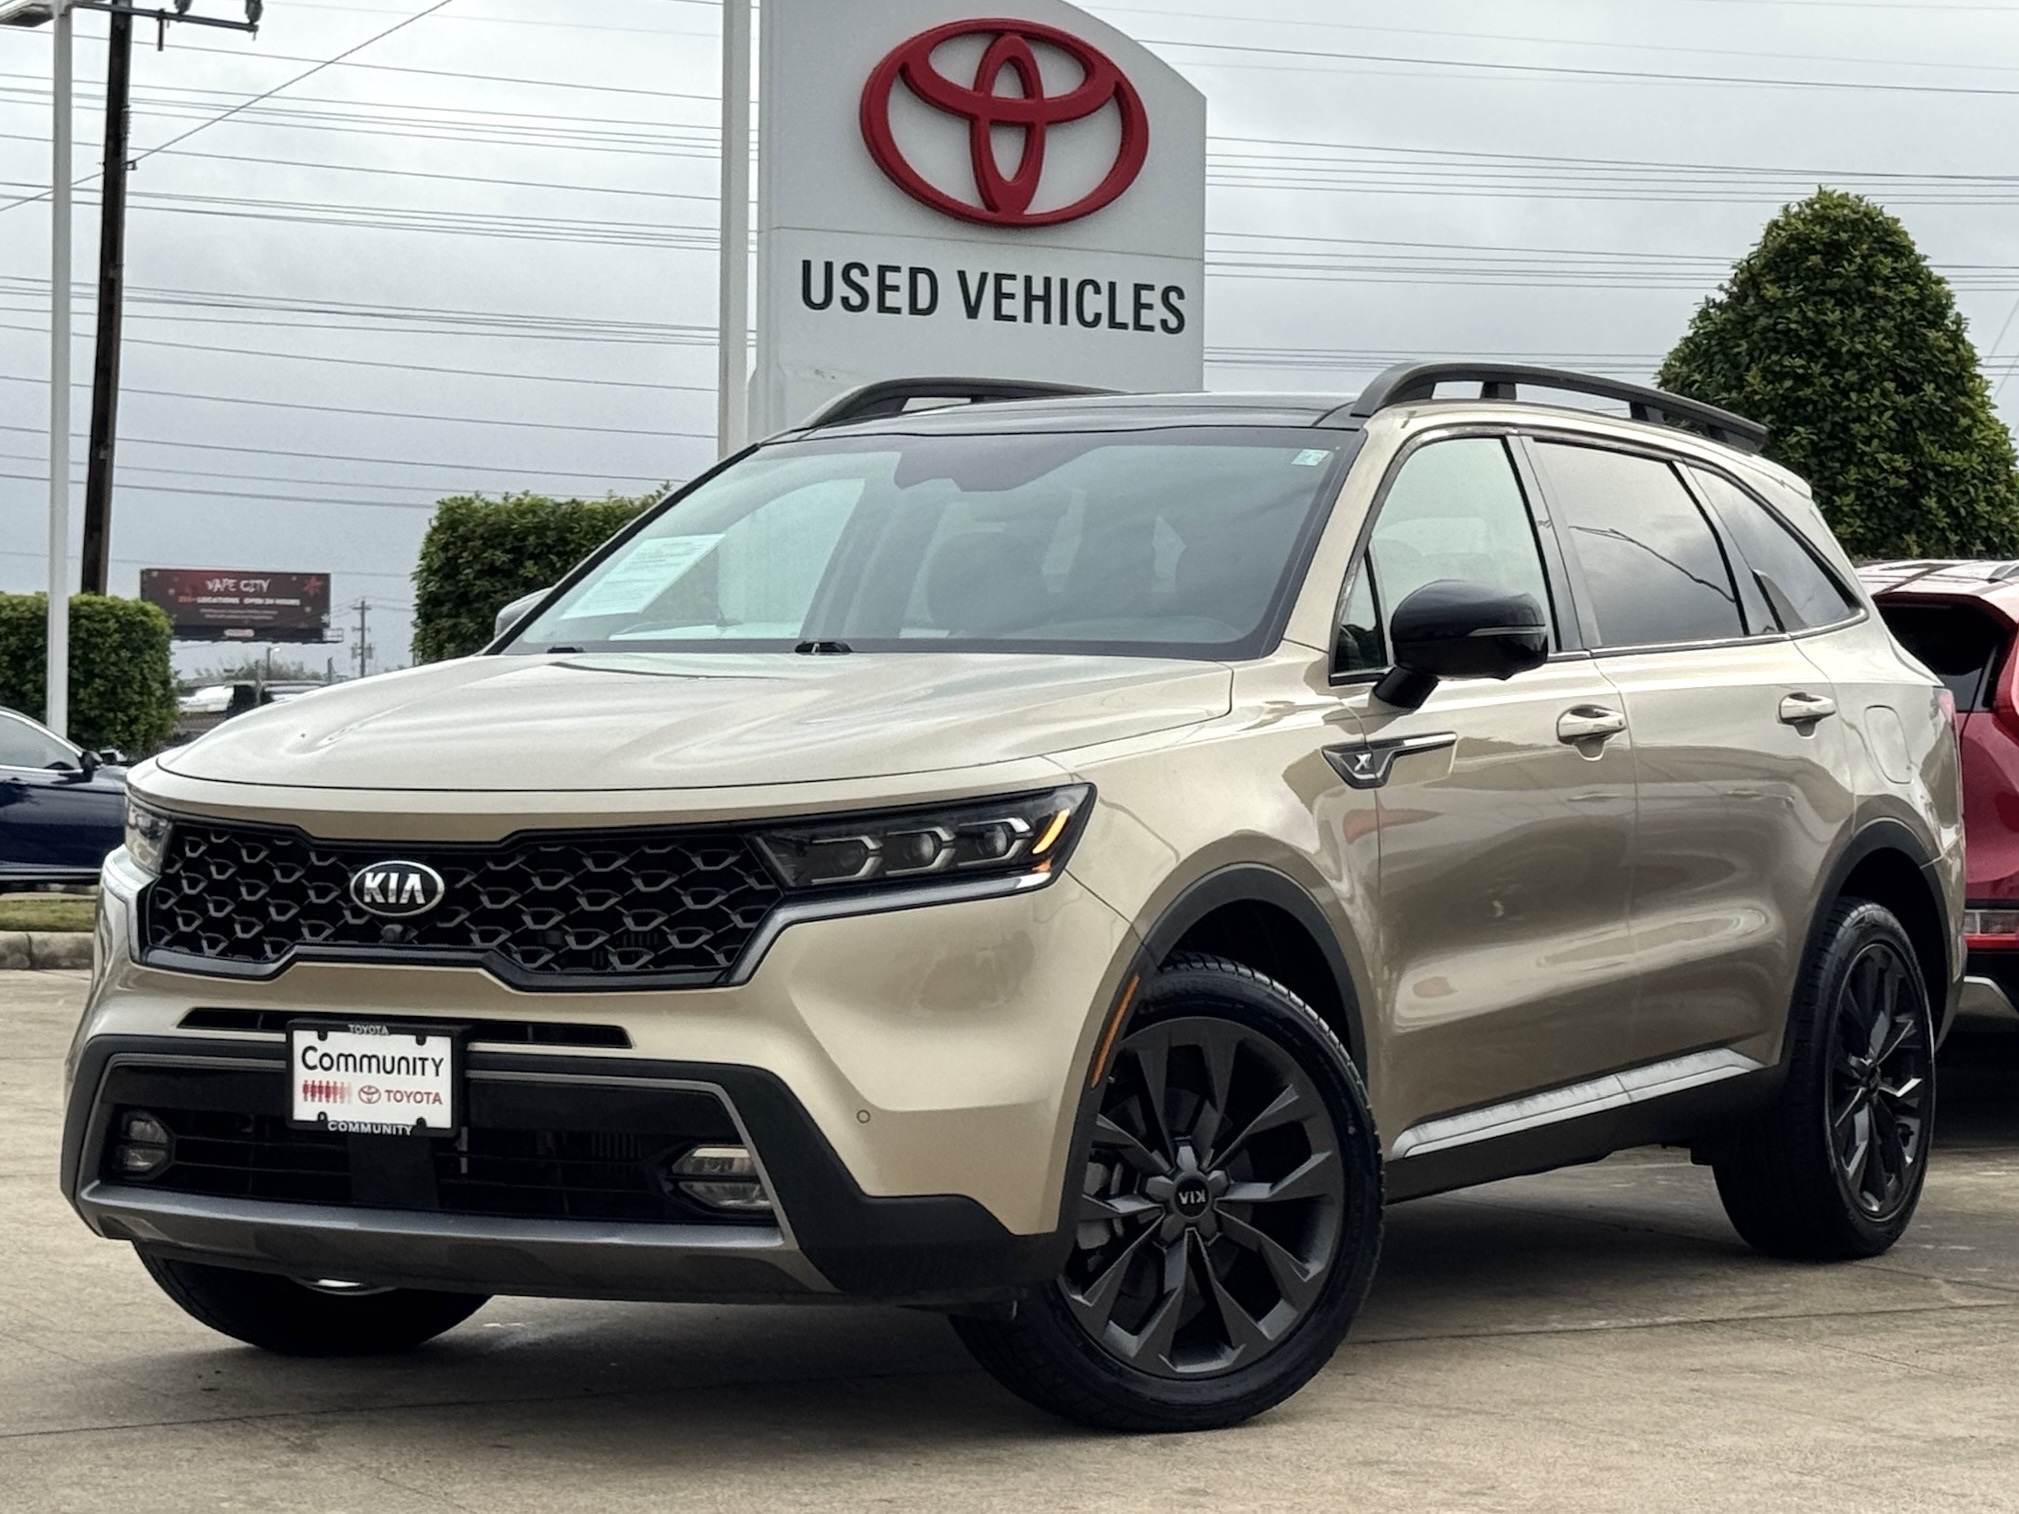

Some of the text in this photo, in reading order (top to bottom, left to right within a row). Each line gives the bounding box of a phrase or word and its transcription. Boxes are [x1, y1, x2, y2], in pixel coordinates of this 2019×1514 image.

[802, 260, 1186, 335] USED VEHICLES
[205, 578, 271, 593] VAPE CITY
[363, 872, 426, 904] KIA
[348, 1024, 390, 1036] TOYOTA
[385, 1089, 443, 1105] TOYOTA
[327, 1120, 414, 1136] COMMUNITY
[1178, 1189, 1206, 1205] KIA
